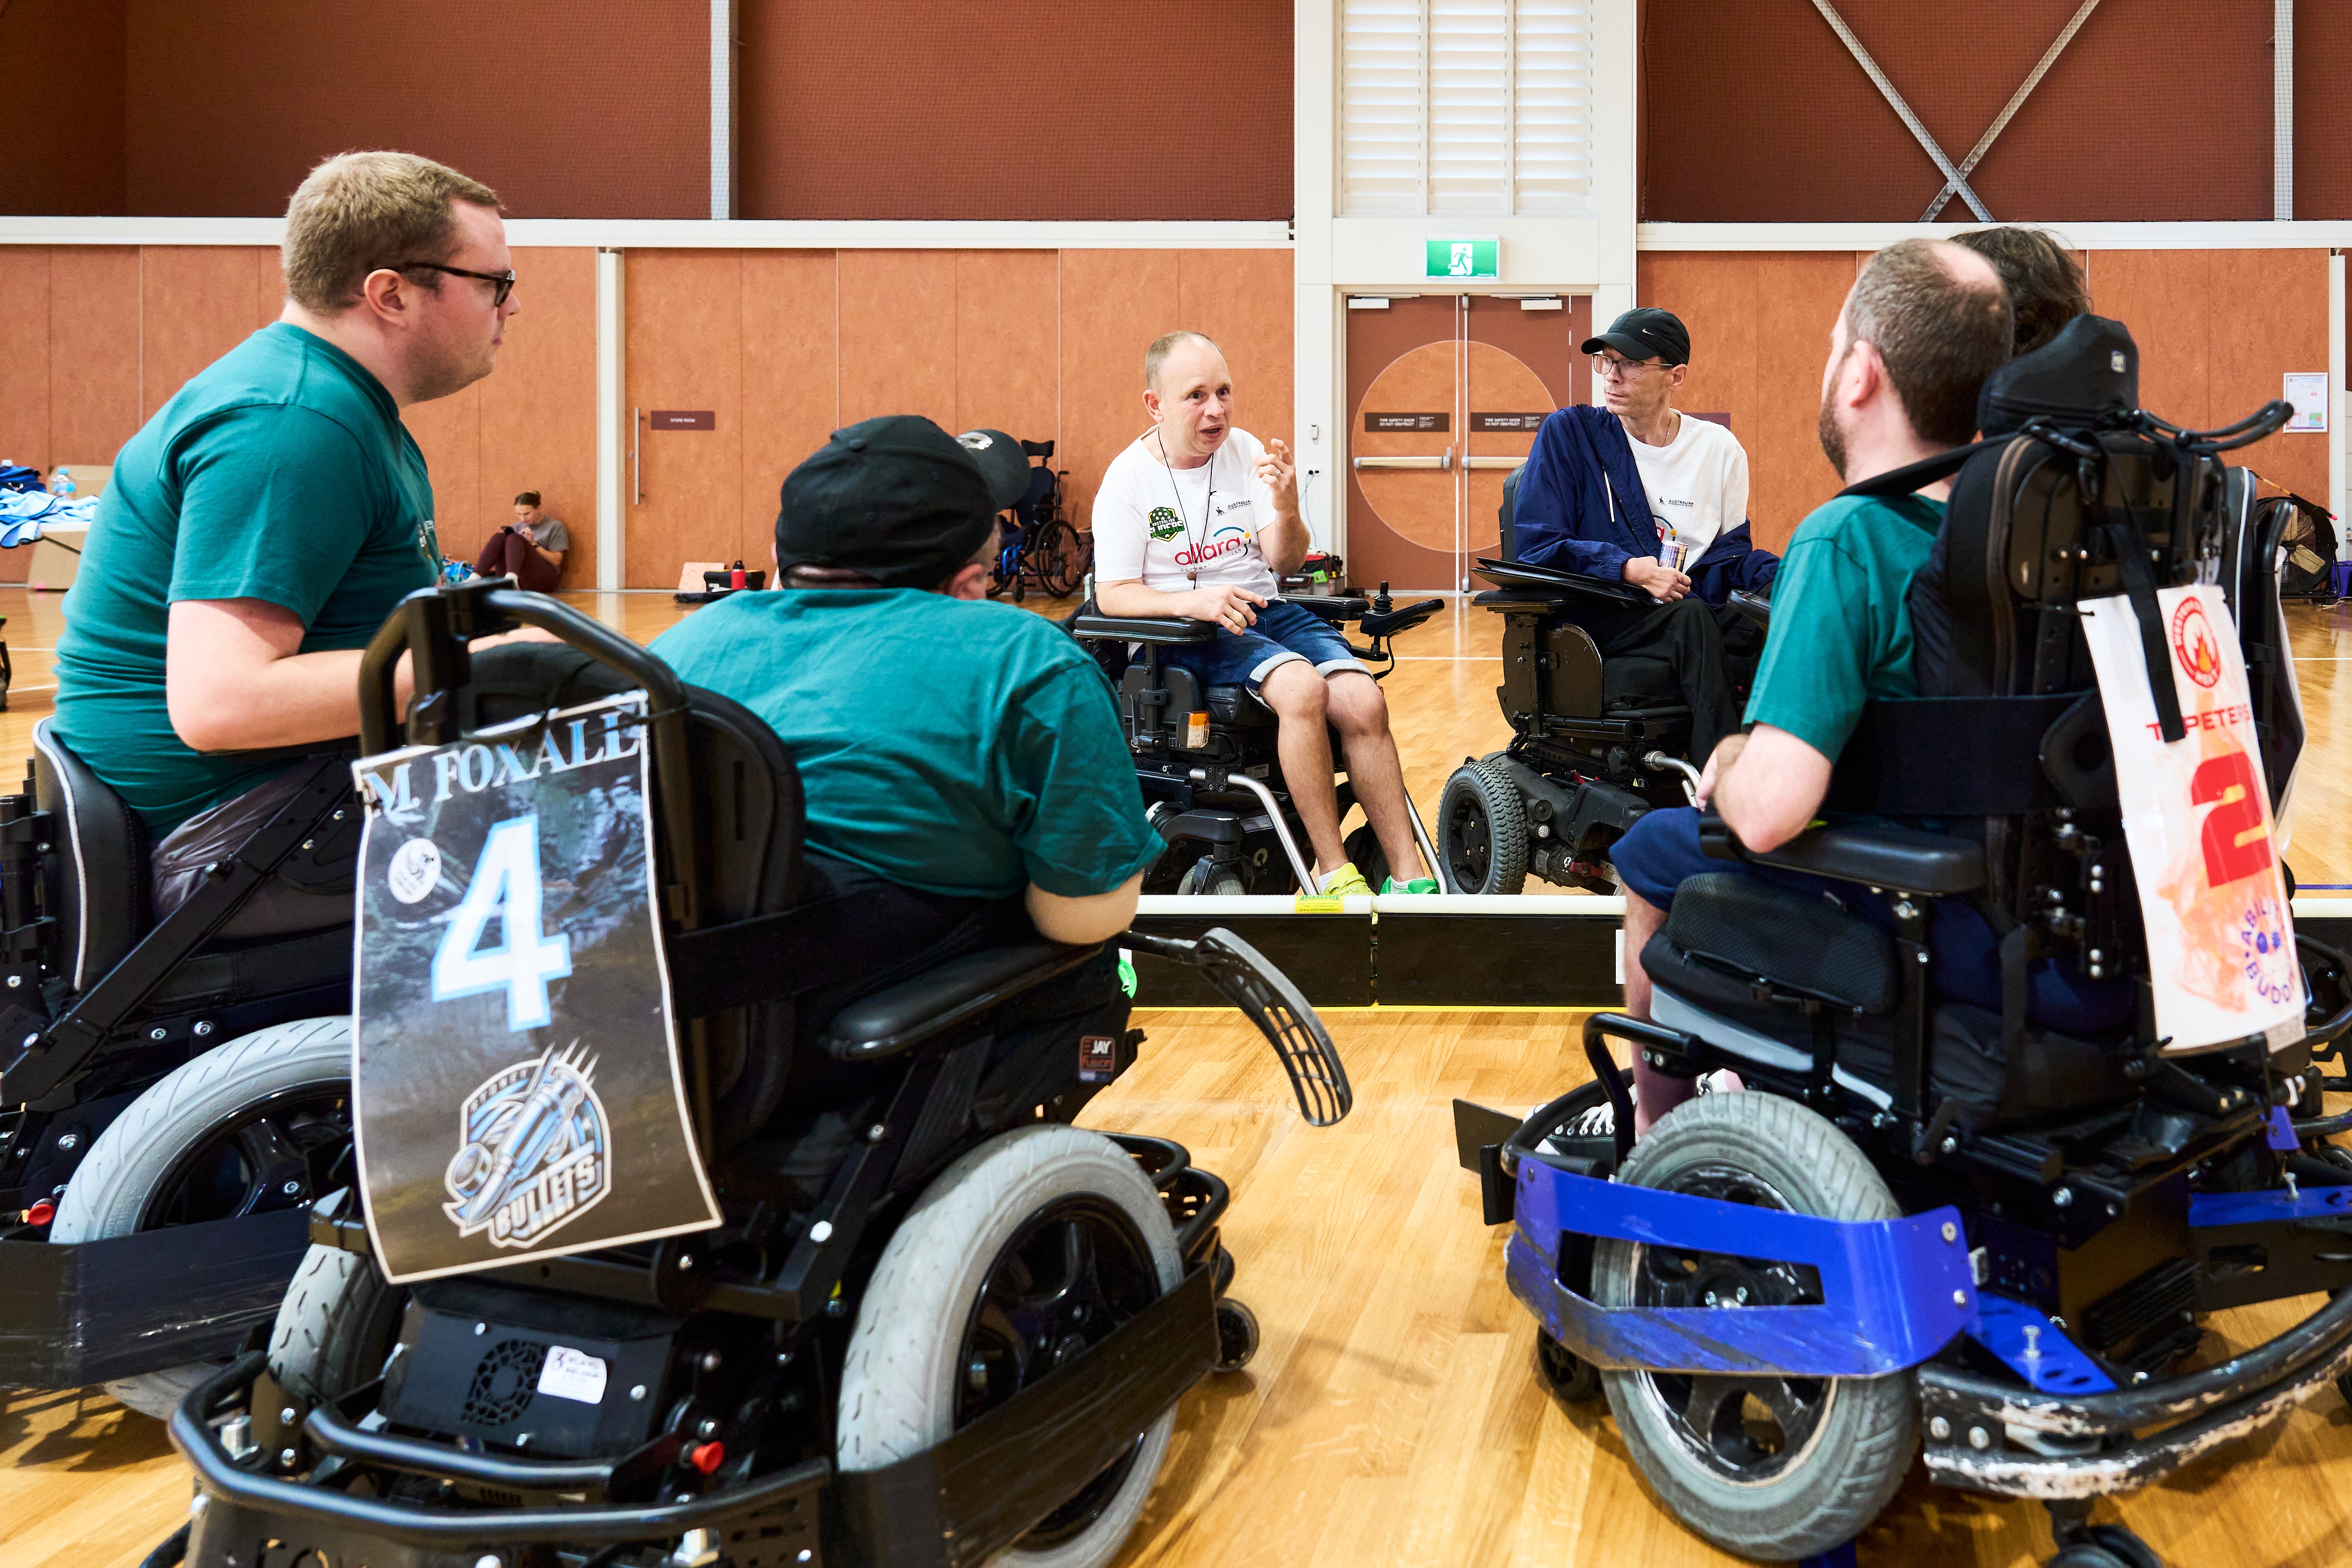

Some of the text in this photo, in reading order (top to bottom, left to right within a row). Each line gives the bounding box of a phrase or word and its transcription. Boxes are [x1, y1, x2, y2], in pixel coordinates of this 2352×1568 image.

[1175, 537, 1240, 565] allara
[1214, 548, 1241, 563] SERVICES
[432, 710, 641, 803] FOXALL
[2191, 751, 2273, 888] 2
[431, 813, 573, 1033] 4
[1091, 1040, 1112, 1054] JAY
[494, 1154, 601, 1238] BULLETS
